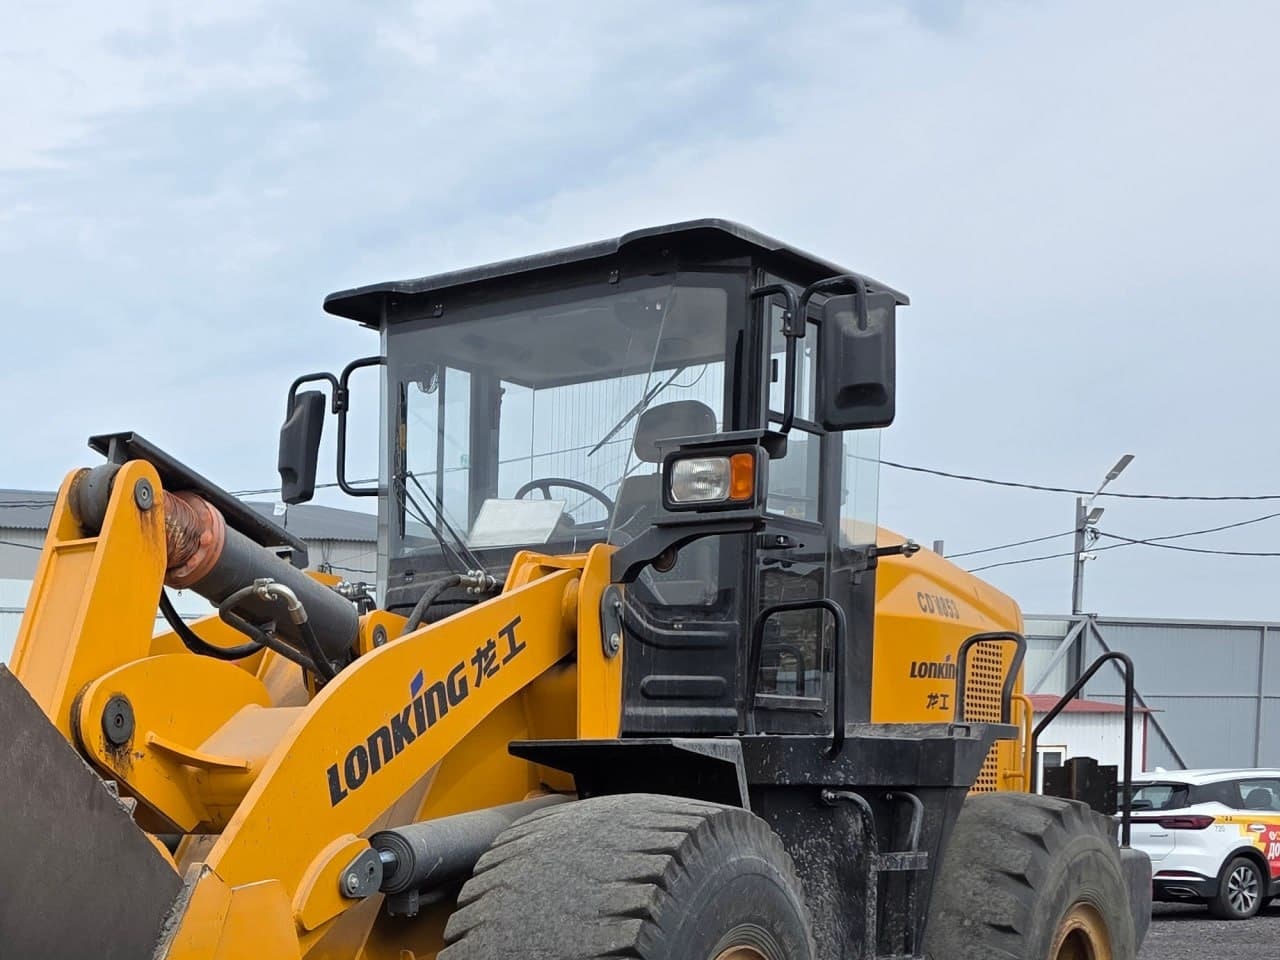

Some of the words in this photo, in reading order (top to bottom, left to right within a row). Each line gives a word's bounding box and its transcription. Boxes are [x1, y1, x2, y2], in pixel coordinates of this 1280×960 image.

[327, 669, 469, 807] LONKING
[471, 615, 527, 688] 龙工
[910, 654, 956, 680] LONKIN
